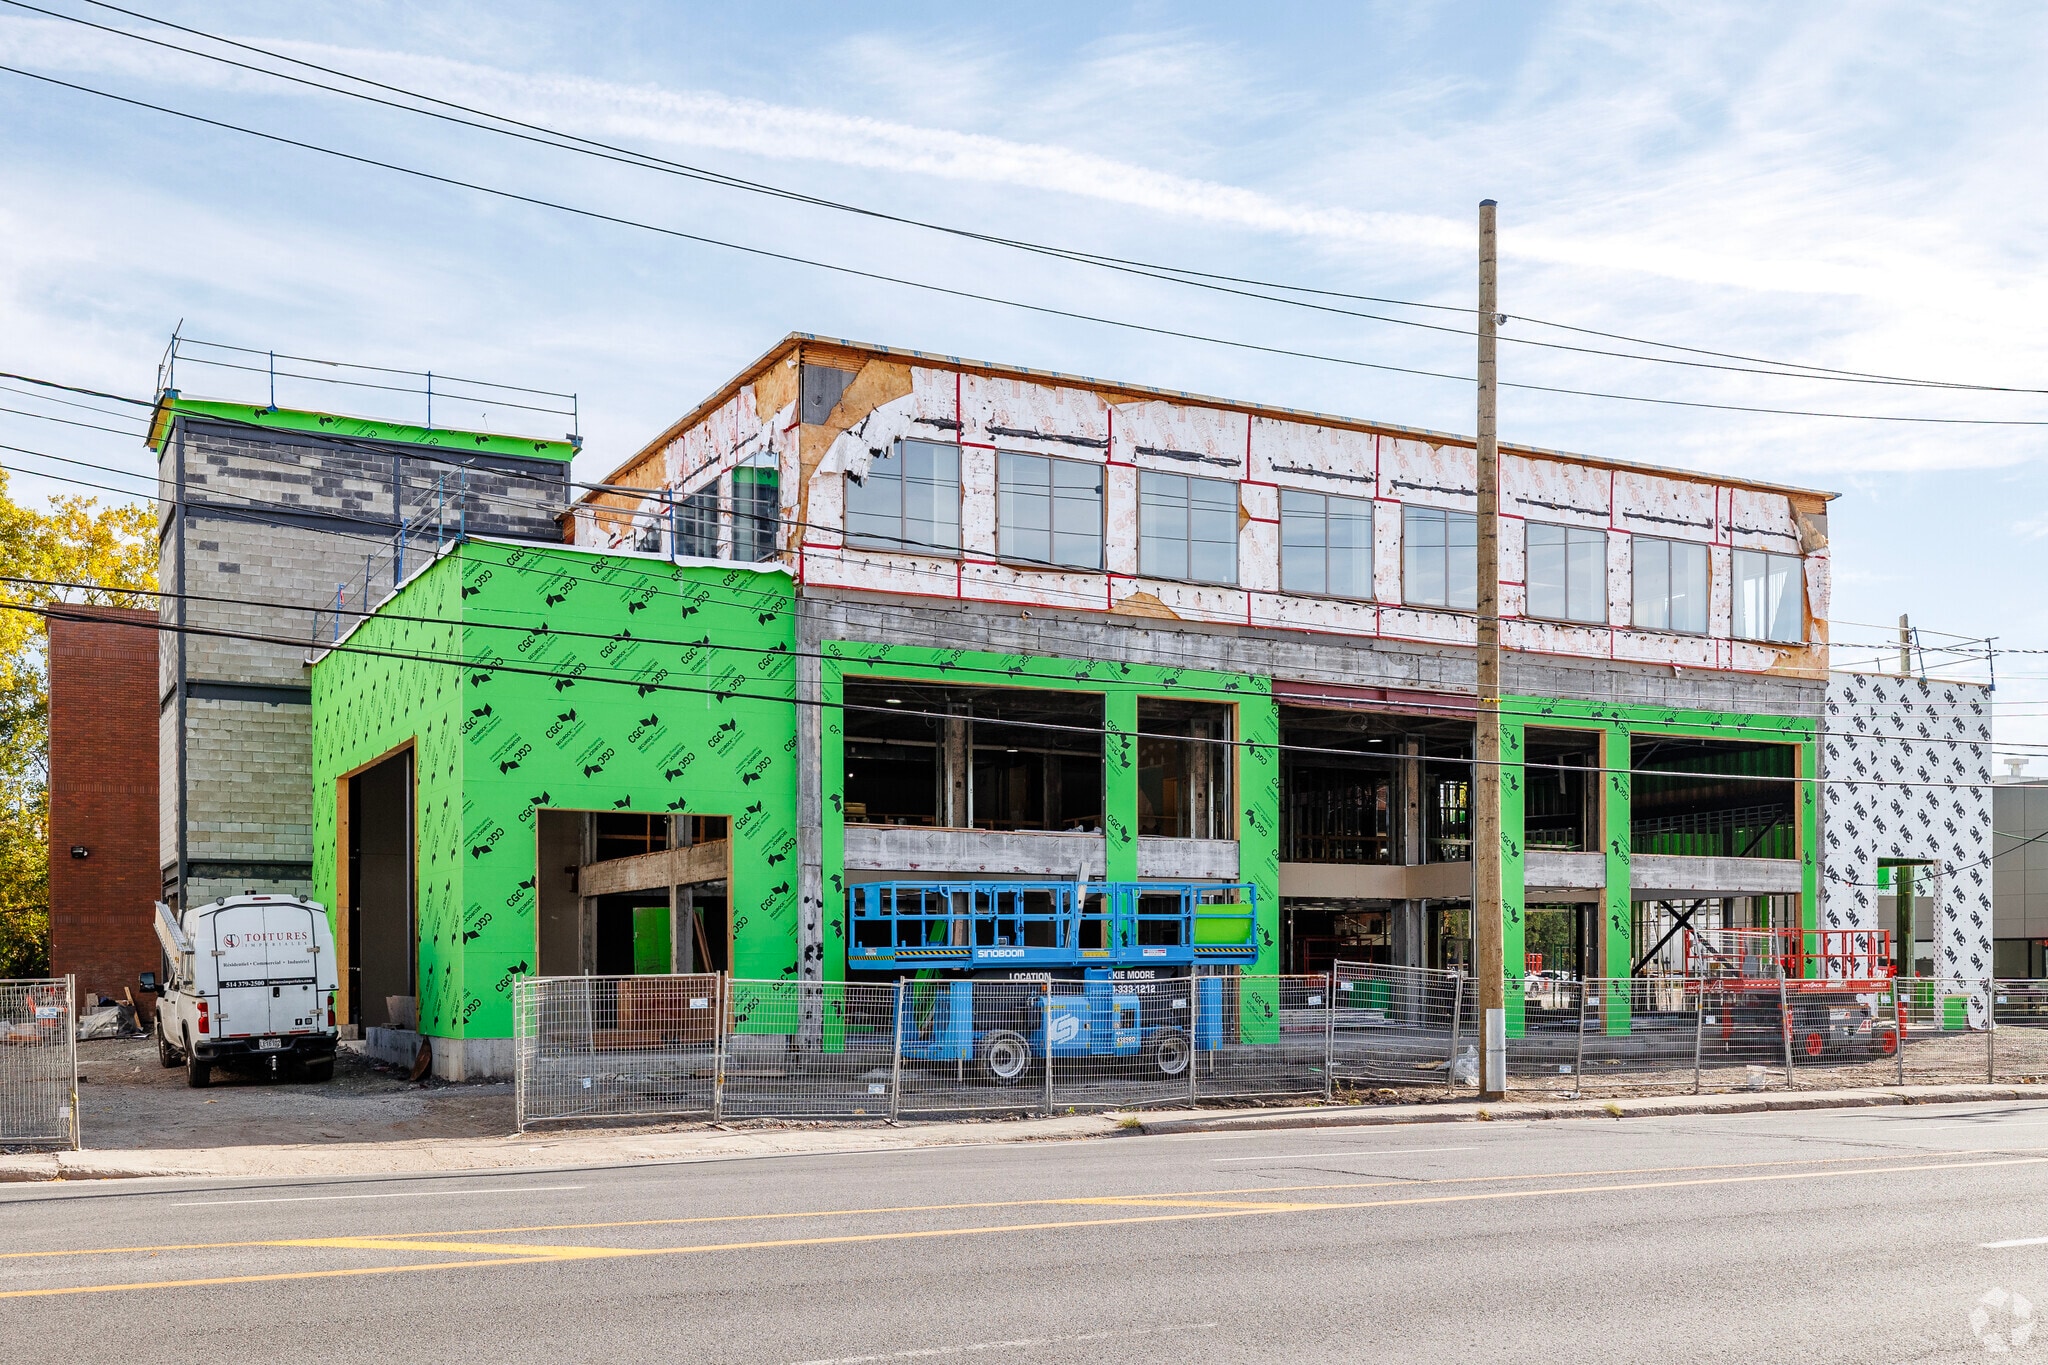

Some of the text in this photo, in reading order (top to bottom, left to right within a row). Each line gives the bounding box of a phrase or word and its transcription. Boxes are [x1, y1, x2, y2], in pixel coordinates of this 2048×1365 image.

[474, 570, 492, 587] CGC
[560, 578, 578, 595] CGC
[723, 570, 739, 586] CGC
[641, 586, 658, 602] CGC
[694, 591, 710, 607] CGC
[771, 597, 787, 613] CGC
[518, 635, 535, 652] CGC
[600, 641, 617, 658] CGC
[681, 648, 698, 664] CGC
[758, 654, 774, 670] CGC
[729, 675, 745, 690] CGC
[1844, 687, 1857, 706] 3M
[1873, 684, 1886, 703] 3M
[1944, 690, 1956, 708] 3M
[1826, 697, 1839, 715] 3M
[1900, 694, 1913, 713] 3M
[546, 722, 563, 738] CGC
[1619, 723, 1629, 737] CGC
[1853, 714, 1866, 732] 3M
[1891, 712, 1904, 731] 3M
[1953, 717, 1965, 733] 3M
[628, 727, 645, 743] CGC
[708, 731, 724, 747] CGC
[1500, 724, 1510, 738] CGC
[1918, 722, 1930, 739] 3M
[1978, 724, 1990, 741] 3M
[514, 744, 532, 761] CGC
[597, 748, 614, 765] CGC
[1255, 751, 1267, 765] CGC
[1826, 743, 1839, 760] 3M
[1926, 748, 1939, 766] 3M
[1970, 742, 1982, 759] 3M
[679, 753, 695, 769] CGC
[756, 757, 771, 773] CGC
[1853, 758, 1866, 776] 3M
[1891, 756, 1904, 774] 3M
[1953, 758, 1965, 776] 3M
[1918, 766, 1930, 783] 3M
[1978, 766, 1990, 784] 3M
[1619, 787, 1629, 800] CGC
[1826, 786, 1839, 805] 3M
[1926, 791, 1939, 809] 3M
[518, 805, 535, 822] CGC
[1854, 802, 1867, 820] 3M
[1891, 799, 1903, 818] 3M
[1953, 800, 1965, 818] 3M
[1979, 808, 1990, 826] 3M
[735, 813, 751, 830] CGC
[1107, 814, 1120, 830] CGC
[1873, 815, 1886, 834] 3M
[1918, 809, 1930, 827] 3M
[1255, 822, 1267, 836] CGC
[1845, 820, 1858, 839] 3M
[1900, 825, 1912, 843] 3M
[1944, 818, 1957, 836] 3M
[1970, 826, 1982, 844] 3M
[486, 828, 504, 845] CGC
[1827, 830, 1840, 849] 3M
[1927, 834, 1939, 852] 3M
[781, 838, 797, 854] CGC
[1953, 843, 1965, 861] 3M
[1619, 851, 1629, 865] CGC
[1854, 846, 1867, 864] 3M
[1826, 864, 1840, 884] 3M
[1845, 864, 1858, 883] 3M
[1970, 869, 1982, 887] 3M
[507, 889, 524, 907] CGC
[761, 894, 776, 911] CGC
[1855, 890, 1868, 908] 3M
[1953, 885, 1965, 903] 3M
[1979, 893, 1991, 911] 3M
[1827, 910, 1840, 928] 3M
[1846, 909, 1859, 927] 3M
[1945, 903, 1957, 921] 3M
[1970, 911, 1983, 929] 3M
[474, 913, 492, 930] CGC
[245, 932, 308, 942] TOITURES
[1619, 926, 1629, 939] CGC
[1953, 928, 1965, 946] 3M
[1979, 936, 1991, 953] 3M
[1945, 946, 1957, 964] 3M
[1971, 953, 1983, 971] 3M
[1009, 972, 1051, 980] LOCATION
[1127, 971, 1155, 979] MOORE
[463, 999, 481, 1016] CGC
[1252, 992, 1264, 1006] CGC
